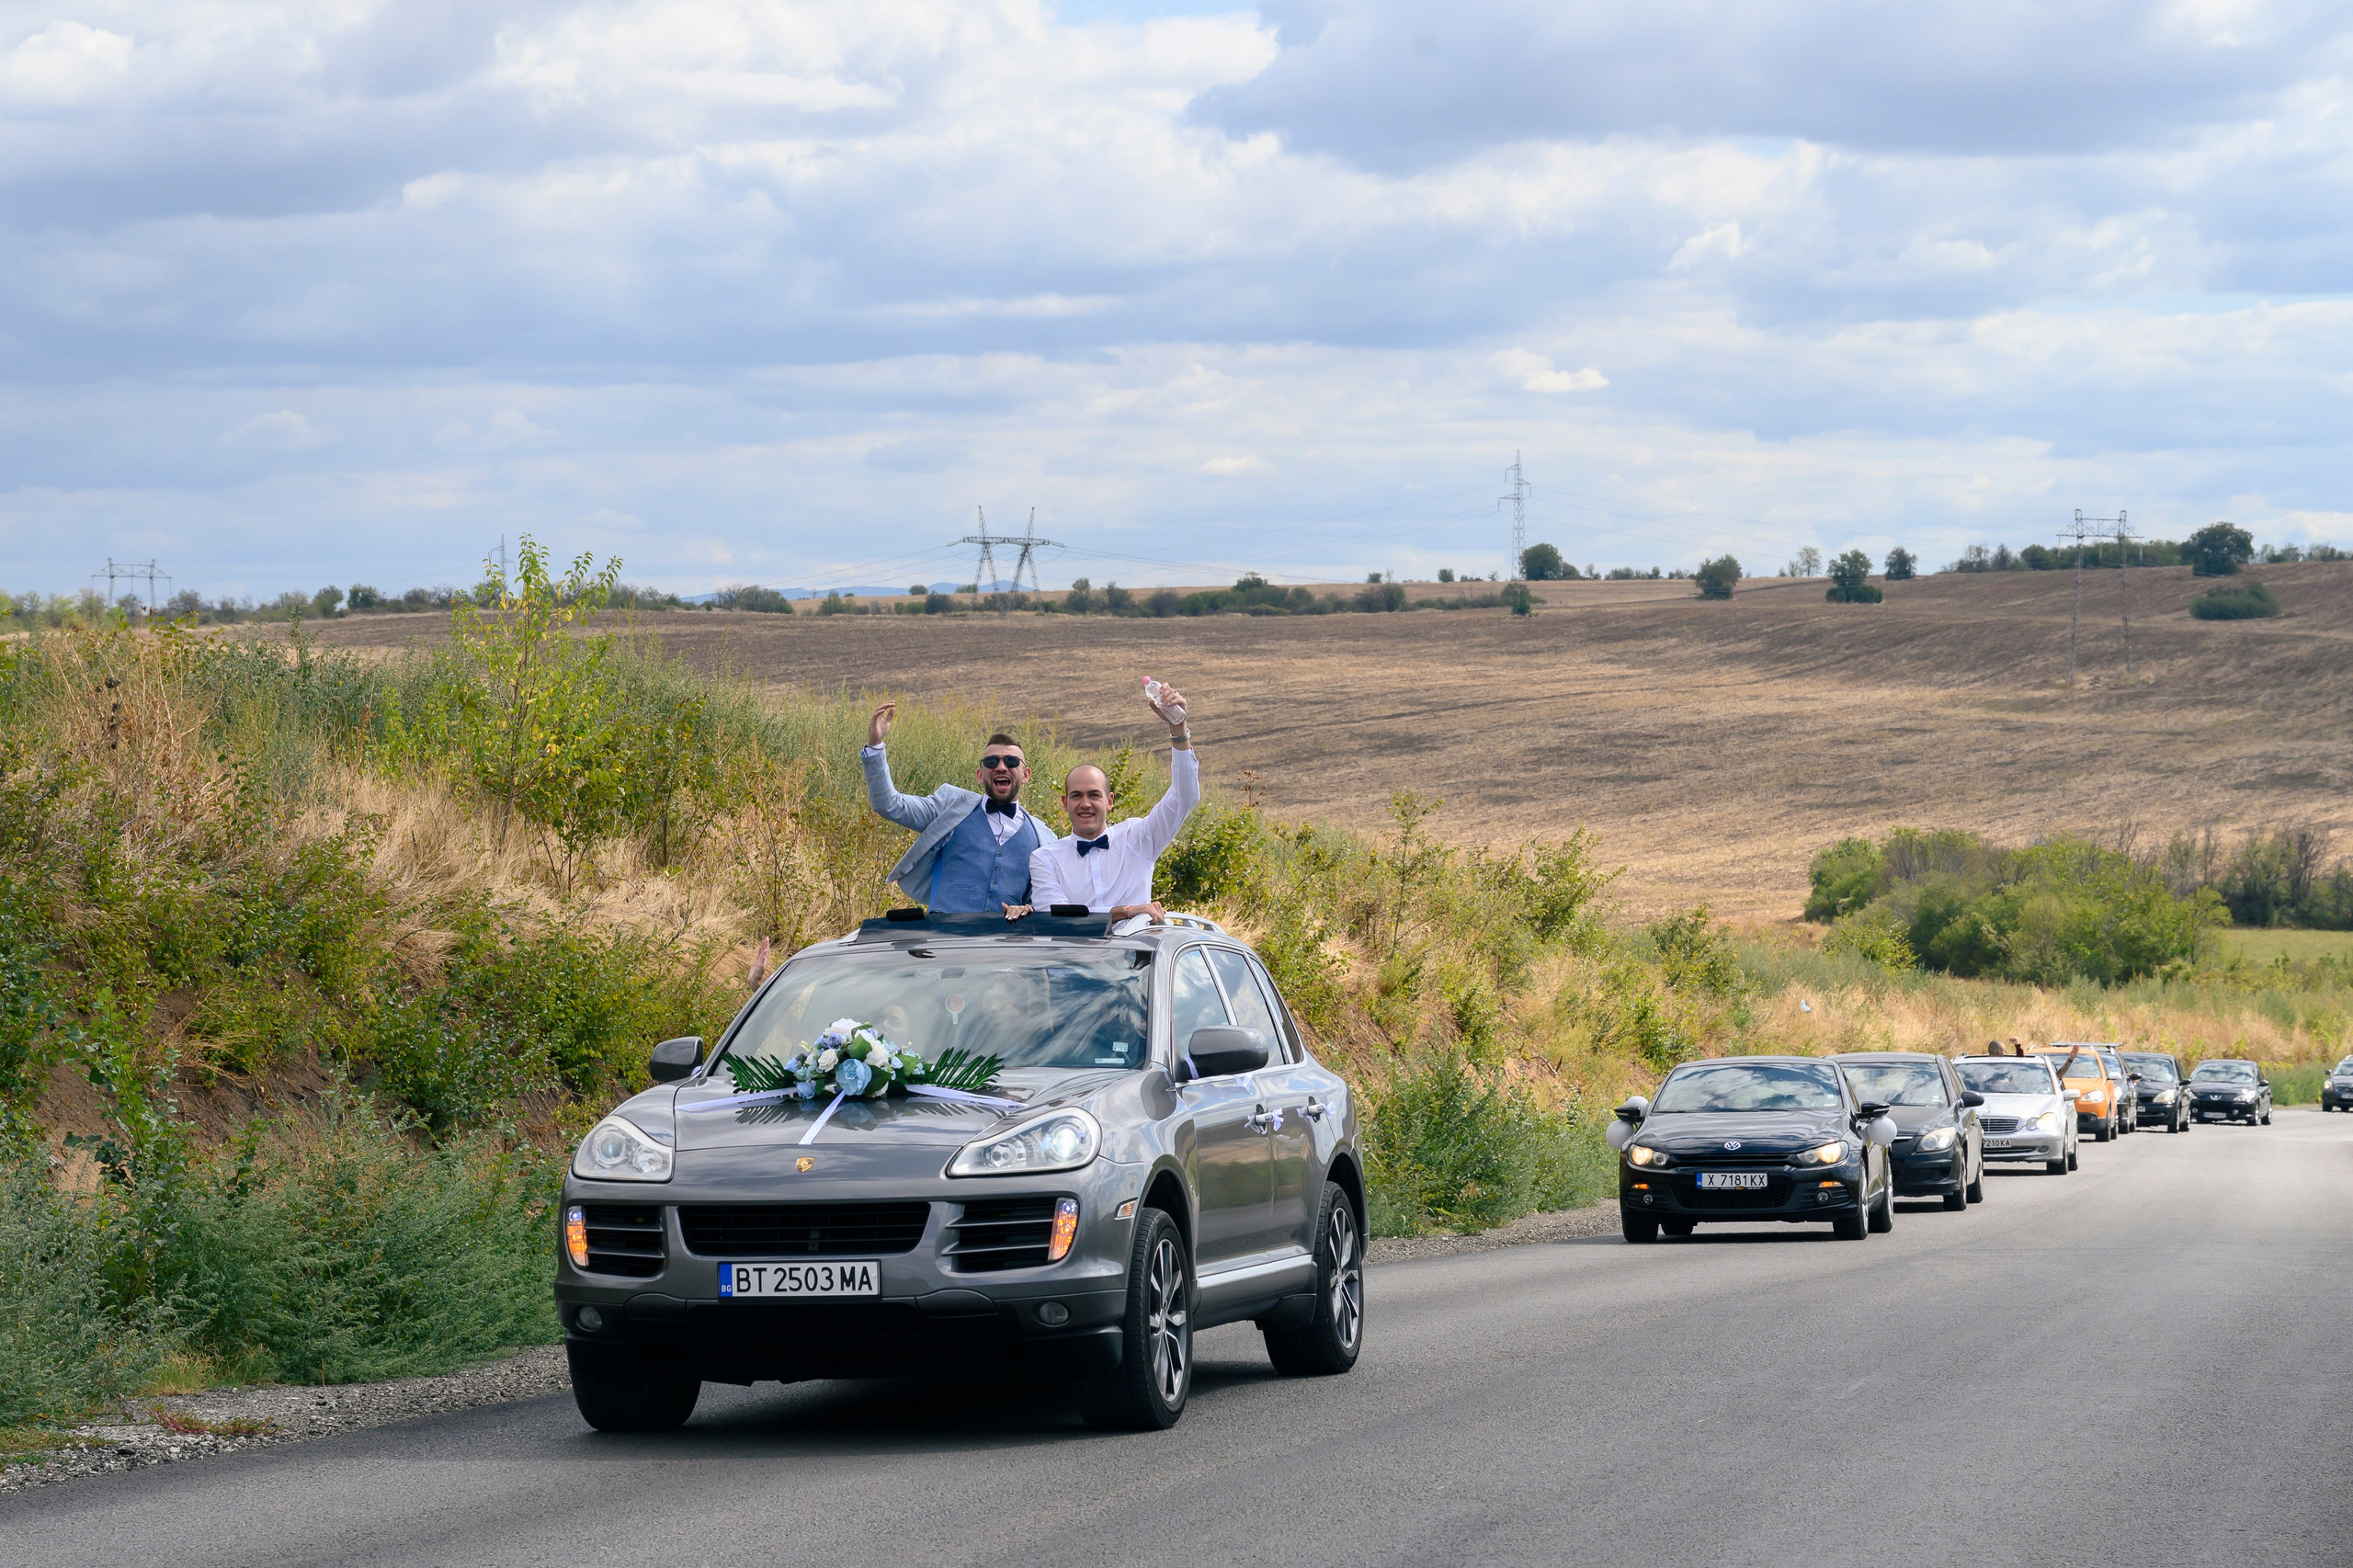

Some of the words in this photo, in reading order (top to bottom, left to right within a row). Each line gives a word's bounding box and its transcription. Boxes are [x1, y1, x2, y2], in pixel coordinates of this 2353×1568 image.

[1708, 1175, 1714, 1186] X
[736, 1267, 767, 1293] BT
[773, 1267, 835, 1292] 2503
[840, 1266, 873, 1291] MA
